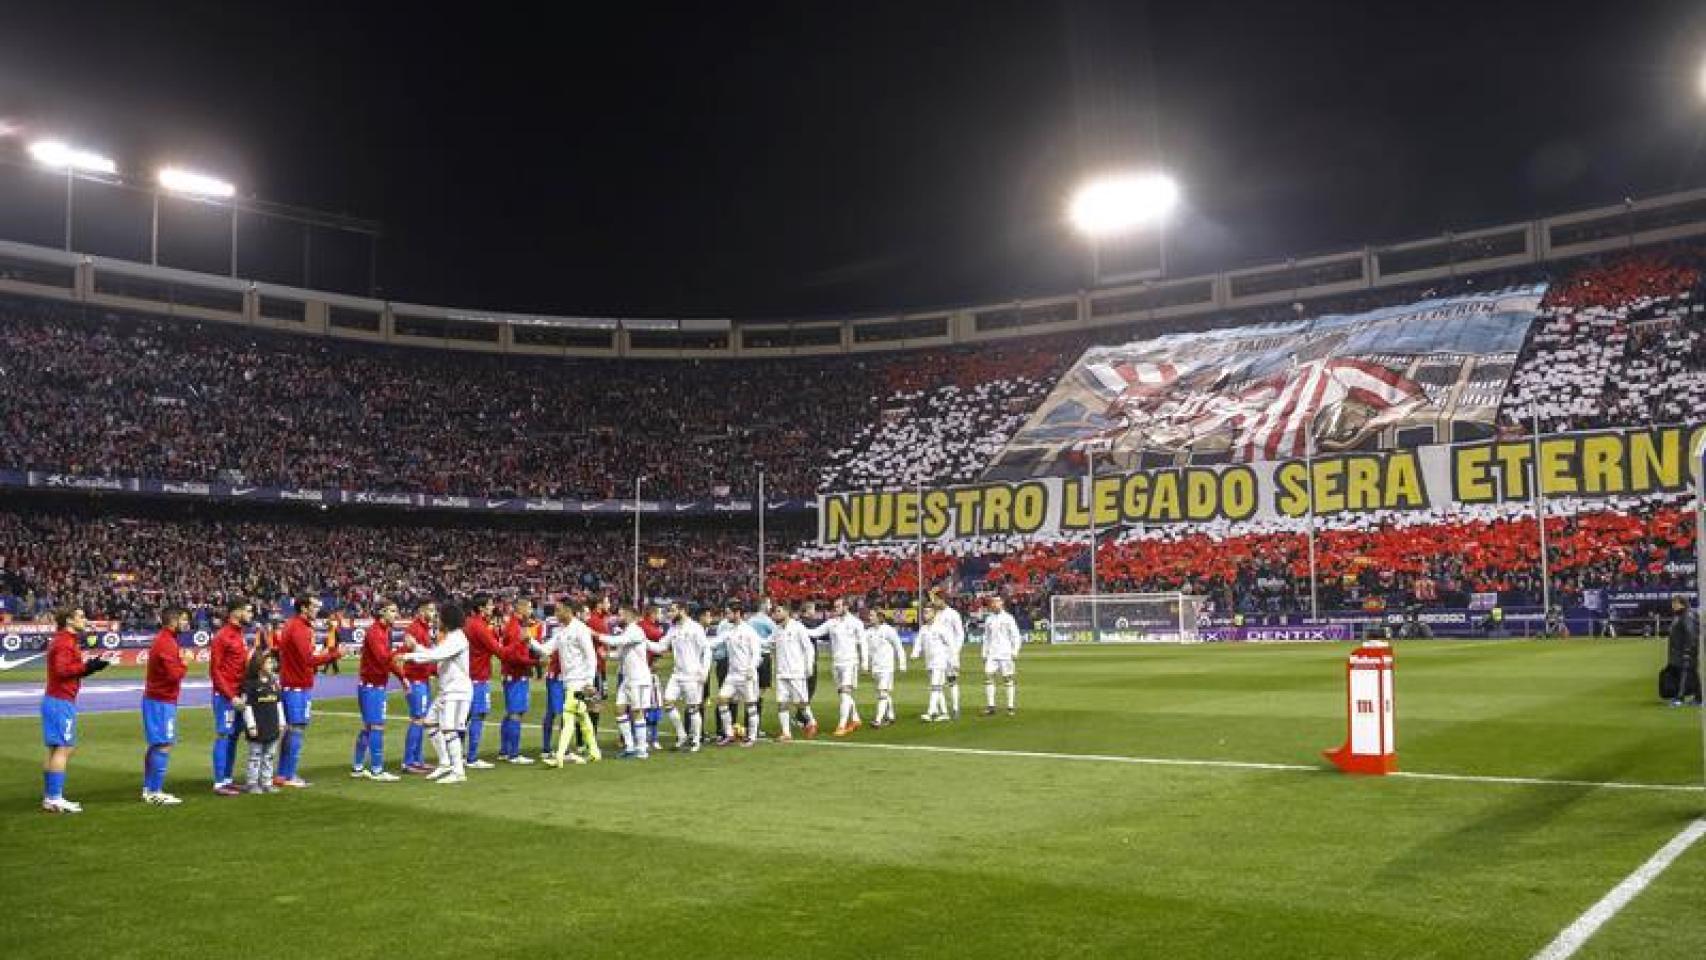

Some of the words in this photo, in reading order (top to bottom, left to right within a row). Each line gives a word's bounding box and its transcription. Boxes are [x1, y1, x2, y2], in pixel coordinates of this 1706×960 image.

[826, 483, 1046, 542] NUESTRO
[1062, 466, 1258, 529] LEGADO
[1276, 450, 1425, 519] SERA
[1247, 631, 1324, 641] DENTIX
